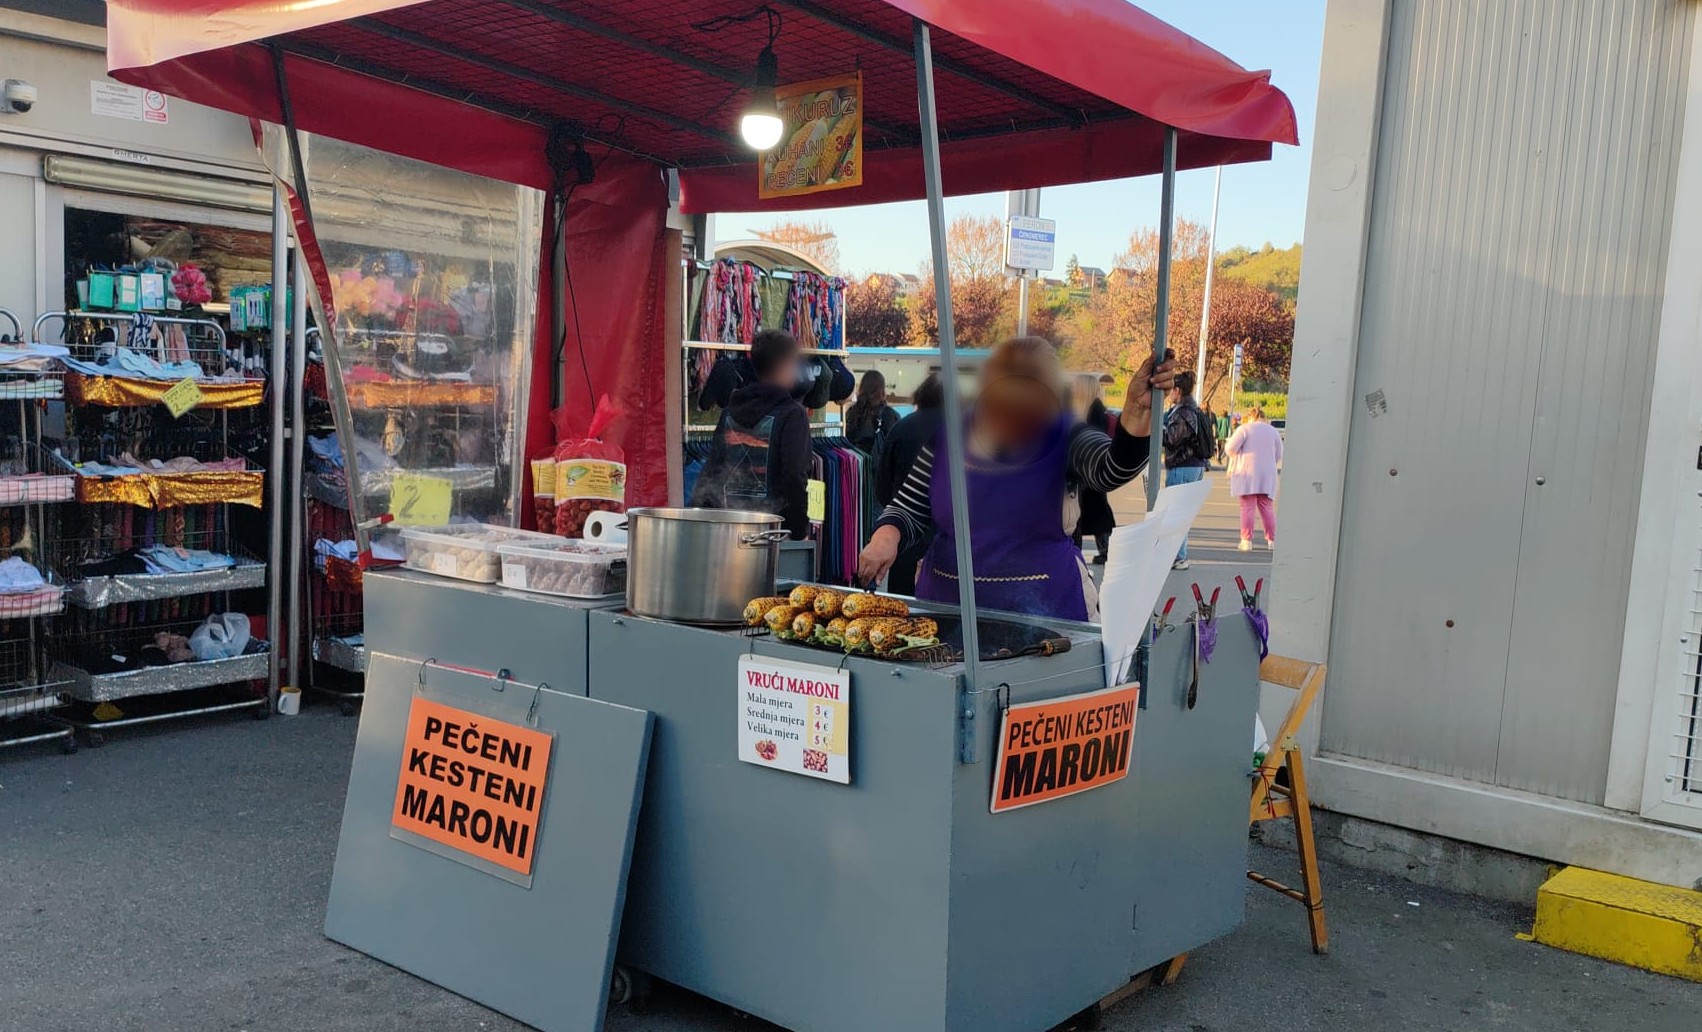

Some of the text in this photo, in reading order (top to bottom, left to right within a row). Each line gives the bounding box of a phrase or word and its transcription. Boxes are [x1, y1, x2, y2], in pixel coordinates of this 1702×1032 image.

[786, 96, 855, 124] KURUZ
[767, 165, 820, 189] PEČENI
[399, 485, 421, 518] 2
[747, 670, 840, 700] VRUĆI MARONI
[747, 692, 767, 705] Mala
[769, 698, 793, 710] mjera
[815, 705, 821, 716] 3
[747, 707, 778, 723] Srednja
[780, 714, 805, 727] mjera
[815, 721, 820, 731] 4
[747, 721, 773, 736] Velika
[775, 729, 799, 741] mjera
[815, 735, 820, 745] 5
[1008, 700, 1135, 750] PEČENI KESTENI
[423, 716, 532, 771] PEČENI
[408, 748, 537, 812] KESTENI
[1001, 729, 1131, 801] MARONI
[401, 784, 529, 859] MARONI
